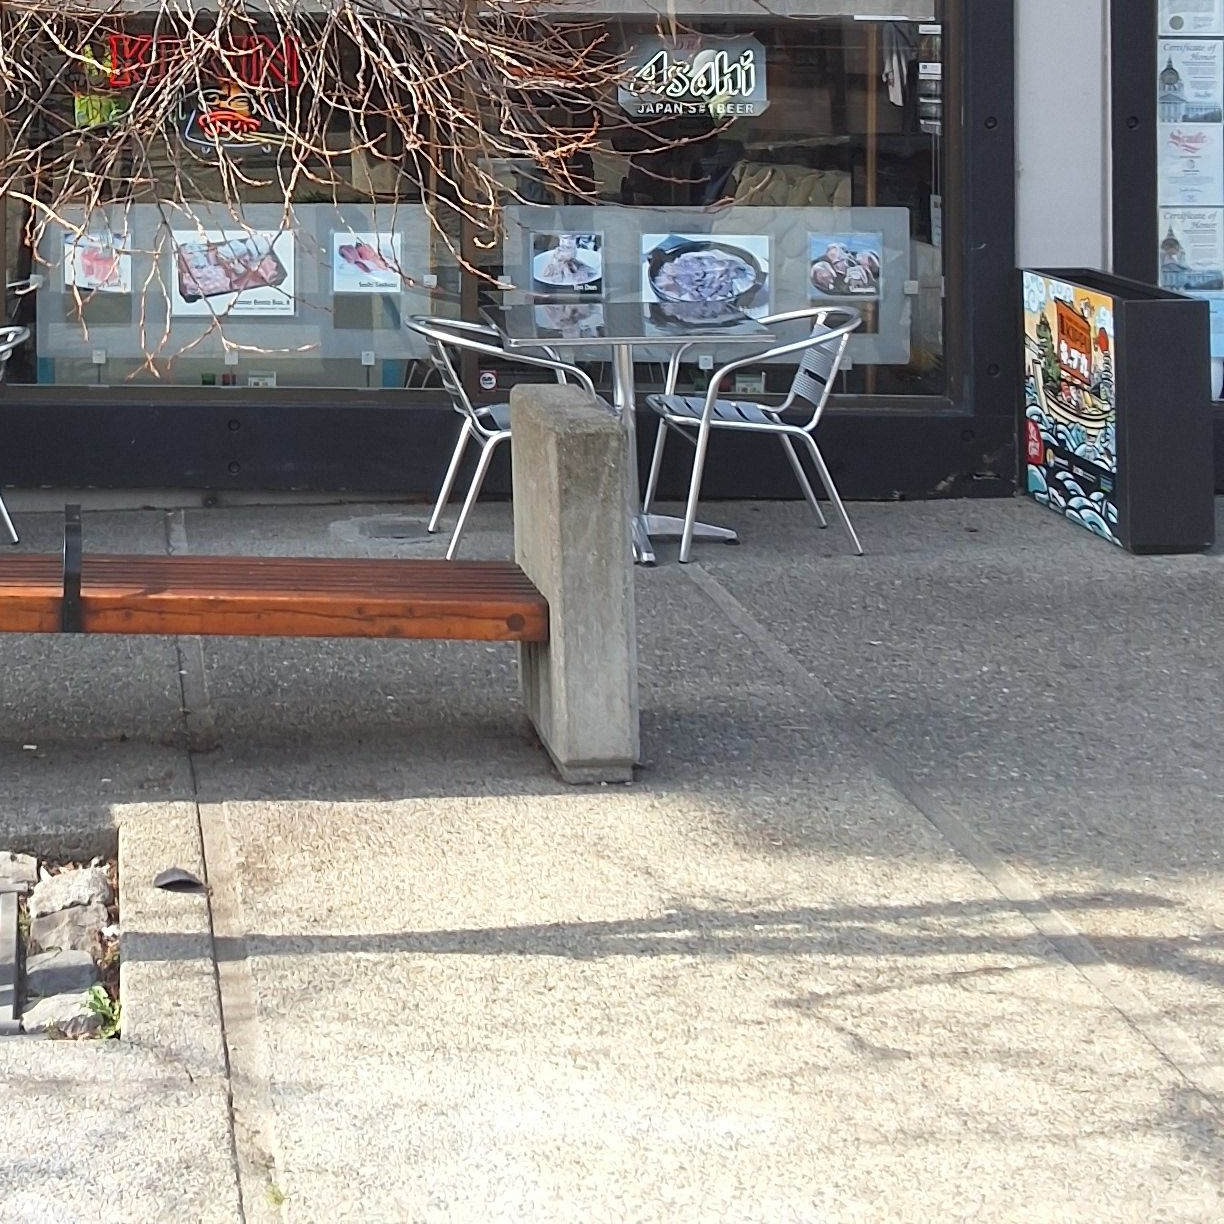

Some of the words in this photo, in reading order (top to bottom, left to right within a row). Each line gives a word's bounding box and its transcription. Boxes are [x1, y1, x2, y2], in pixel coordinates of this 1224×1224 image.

[109, 34, 300, 88] KIIN
[629, 49, 755, 98] Asahi
[637, 103, 698, 115] JAPANS
[717, 103, 755, 115] BEER
